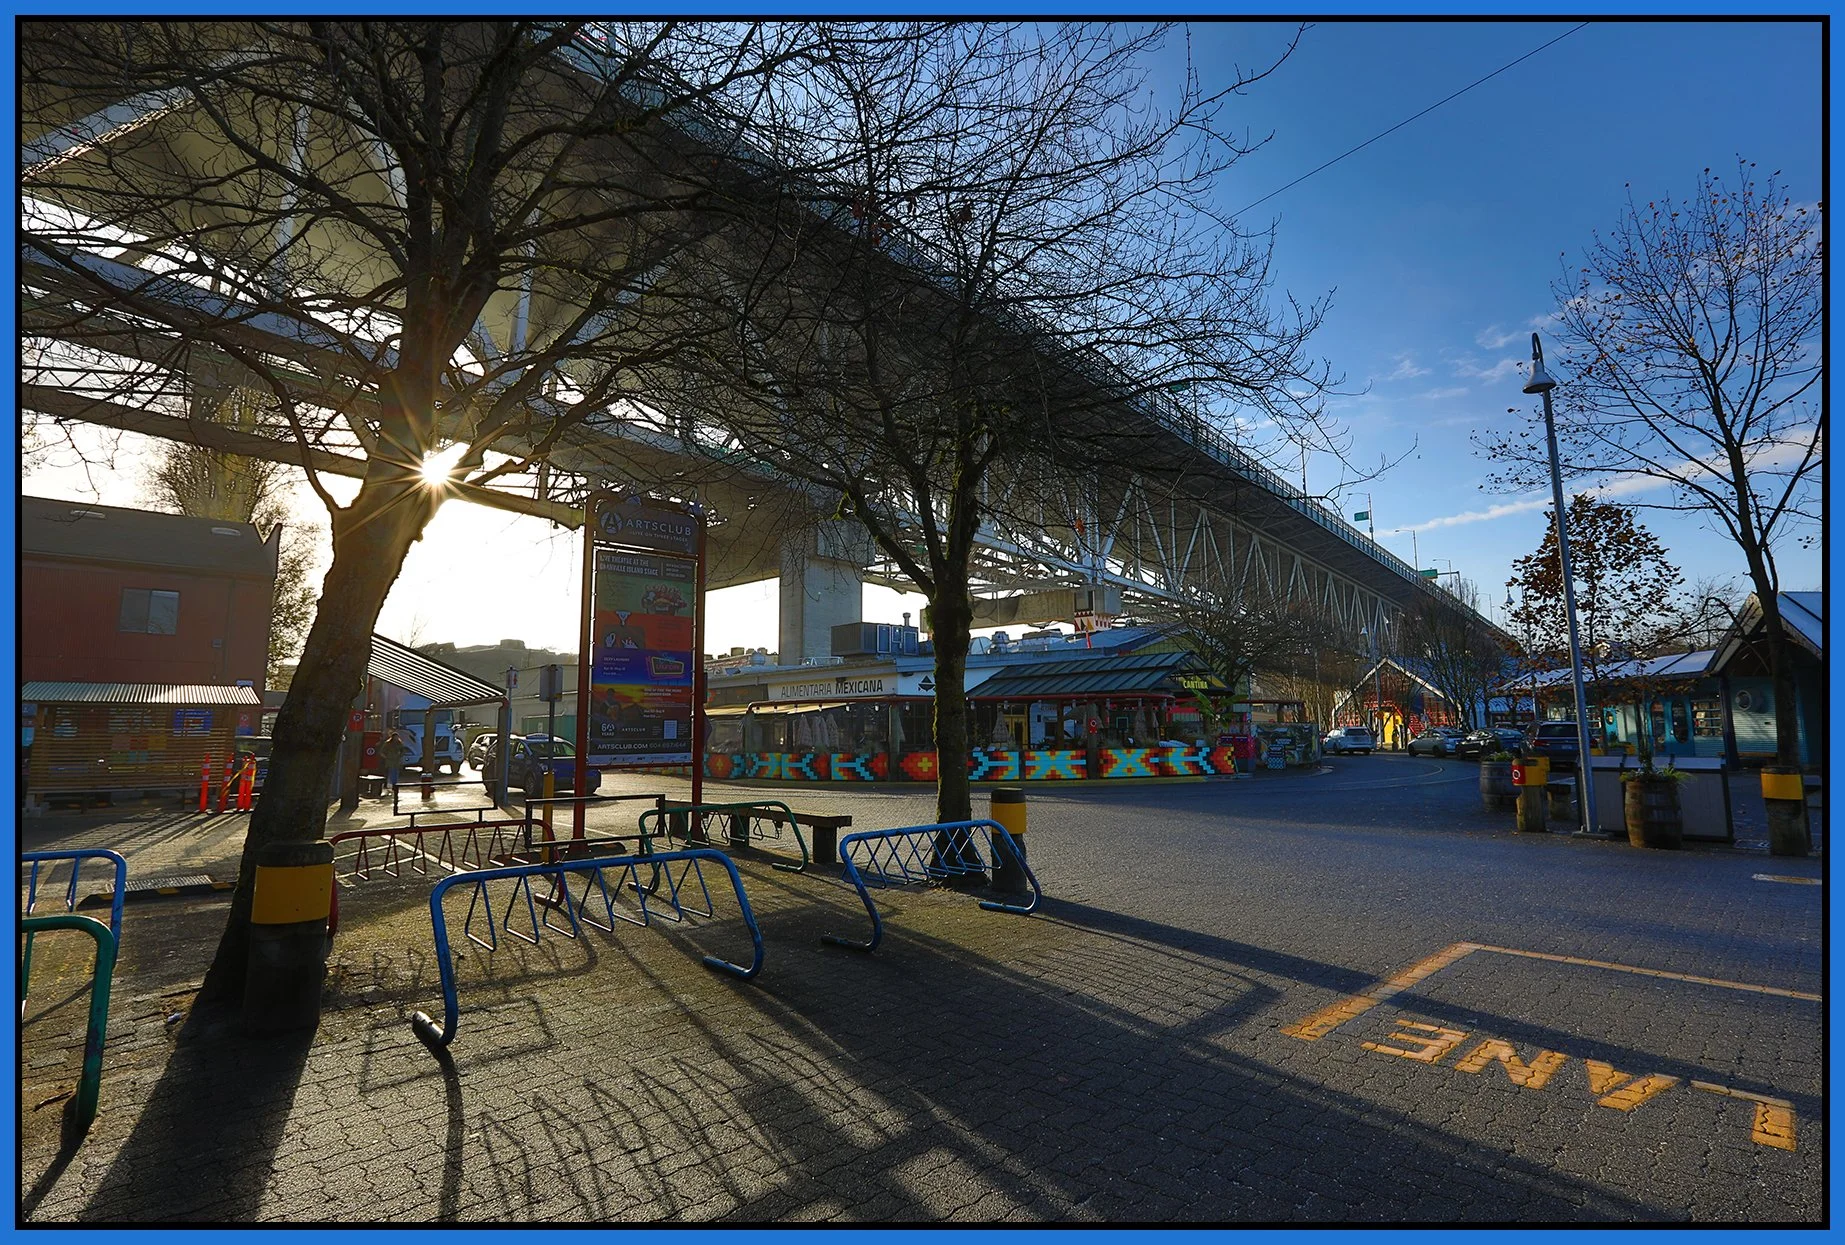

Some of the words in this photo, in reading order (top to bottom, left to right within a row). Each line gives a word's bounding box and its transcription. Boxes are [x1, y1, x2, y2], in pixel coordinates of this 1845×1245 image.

[626, 519, 691, 536] ARTSCLUB
[640, 559, 649, 567] THE
[781, 683, 832, 698] ALIMENTARIA
[836, 680, 883, 695] MEXICANA
[1183, 680, 1209, 690] CANTINA
[1360, 1019, 1798, 1152] LANE
